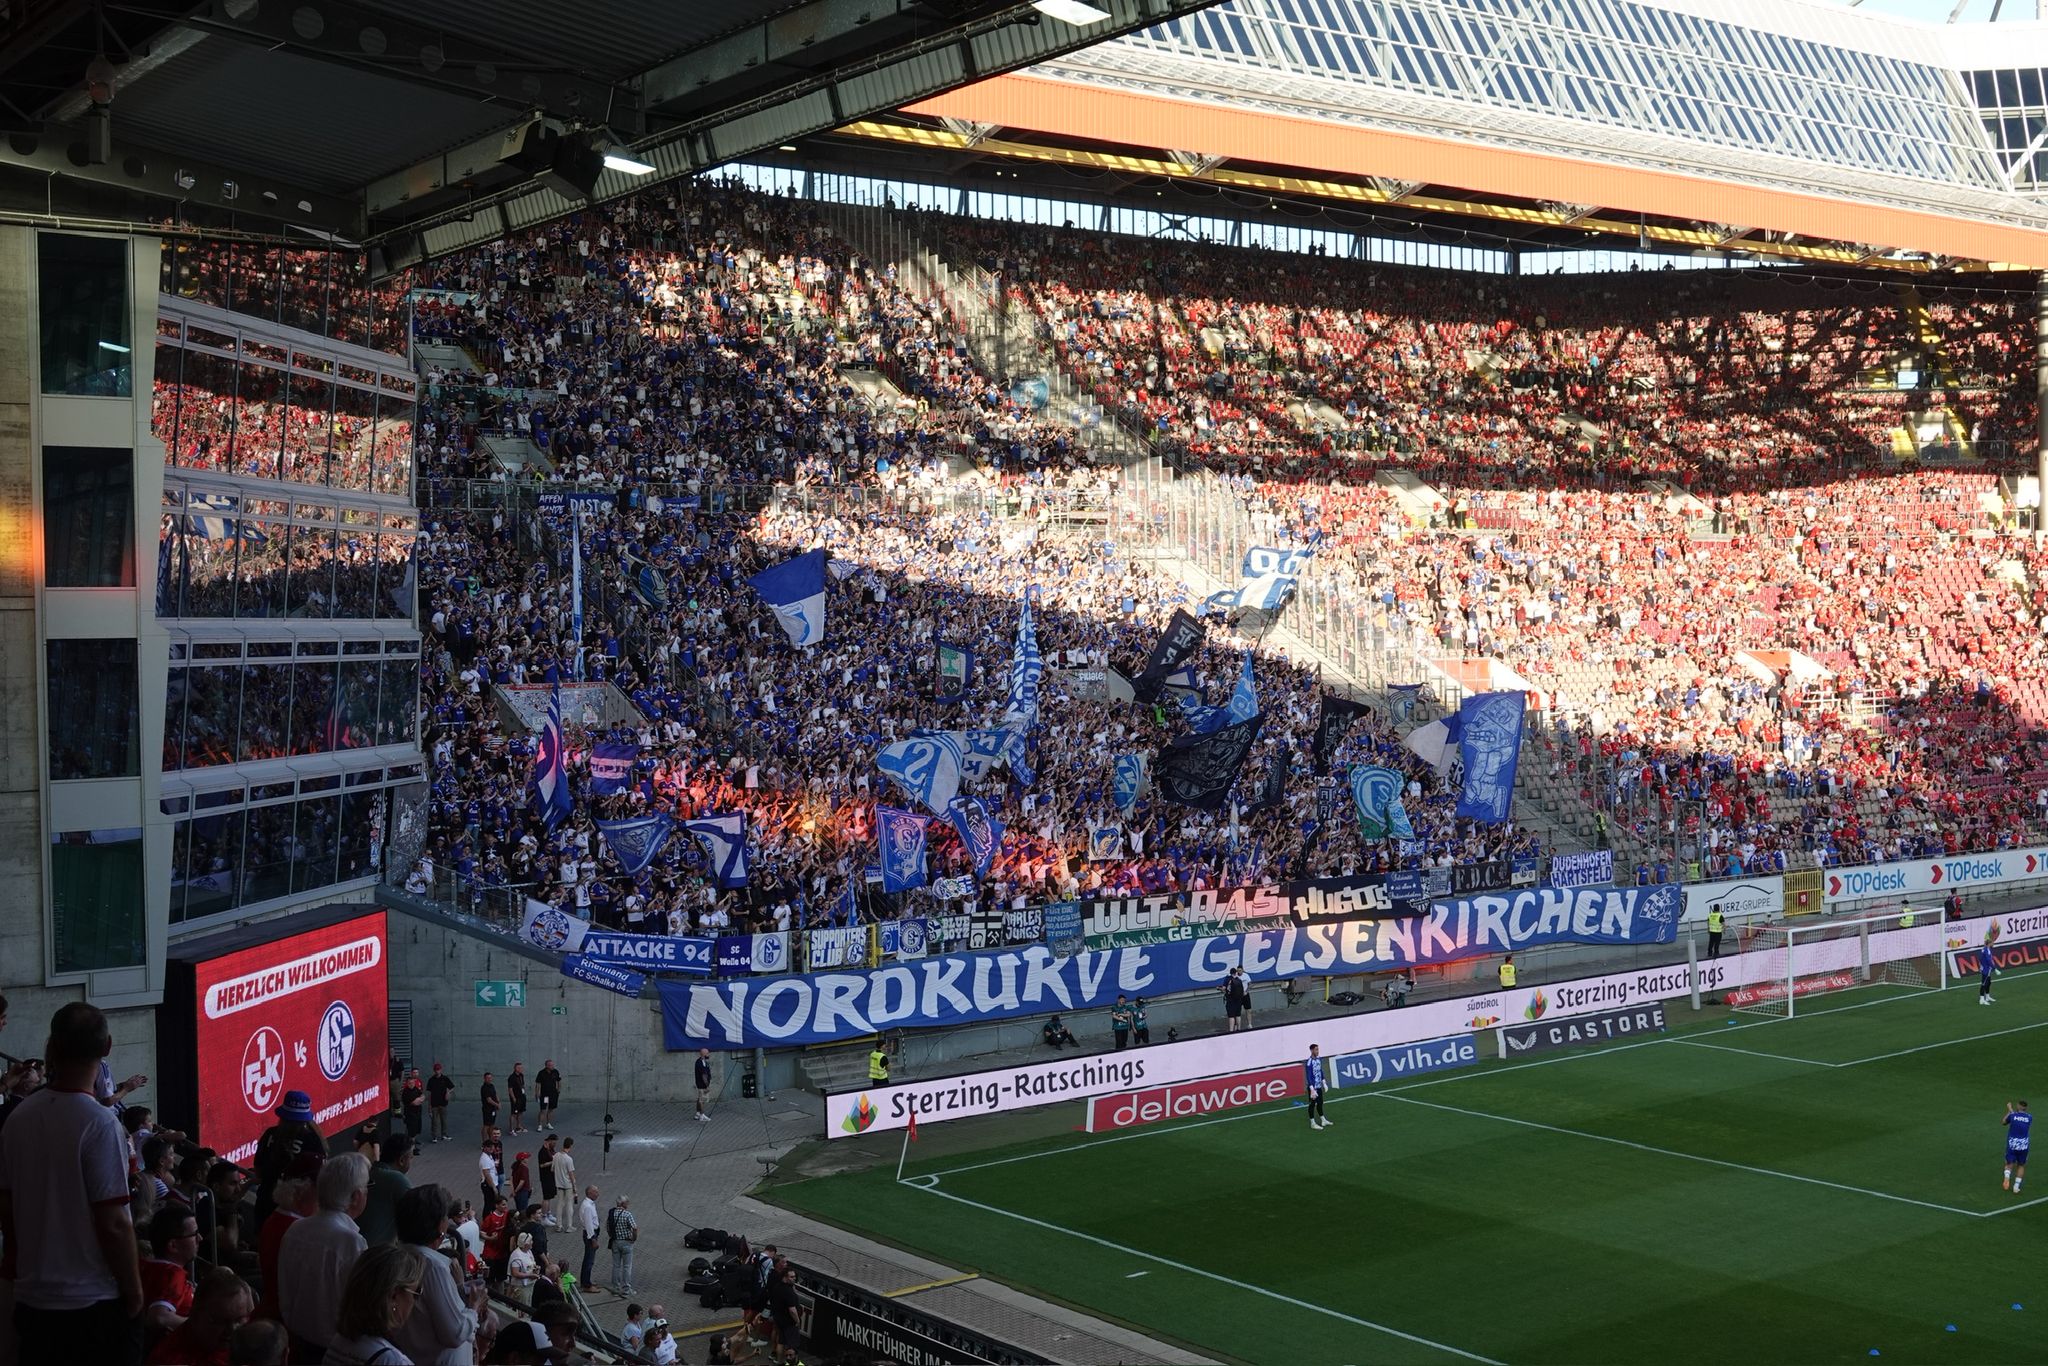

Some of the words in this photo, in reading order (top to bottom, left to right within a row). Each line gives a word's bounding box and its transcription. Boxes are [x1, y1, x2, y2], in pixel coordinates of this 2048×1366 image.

[1552, 850, 1612, 872] DUDENHOFEN
[1945, 858, 2003, 882] TOPdesk
[2038, 852, 2048, 871] T
[1551, 866, 1612, 888] HARTSFELD
[1844, 869, 1906, 895] TOPdesk
[1293, 883, 1393, 920] HUGOS
[1709, 897, 1771, 913] NUERZ-GRUPPE
[943, 916, 970, 929] BLUE
[943, 927, 970, 940] BOYZ
[1005, 923, 1040, 940] JUNGS
[1187, 889, 1639, 980] GELSENKIRCHEN
[585, 938, 675, 961] ATTACKE
[683, 945, 711, 963] 94
[730, 945, 740, 954] SC
[811, 927, 867, 949] SUPPORTERS
[740, 956, 751, 965] 04
[811, 946, 843, 968] CLUB
[1957, 944, 2048, 975] NVOLI
[217, 973, 285, 1012] HERZLICH
[288, 943, 374, 988] WILLKOMMEN
[573, 966, 585, 978] FC
[585, 971, 616, 988] Schalke
[616, 982, 627, 992] 04
[1556, 966, 1725, 1010] Sterzing-Ratschngs
[685, 945, 1155, 1043] NORDKURVE
[1549, 1009, 1665, 1044] CASTORE
[294, 1039, 307, 1068] VS
[1390, 1041, 1475, 1072] vlh.de
[363, 1084, 380, 1103] UHR
[890, 1057, 1146, 1120] Sterzing-Ratschings
[1113, 1075, 1289, 1127] delaware
[835, 1316, 921, 1366] MARKTFÜHRER
